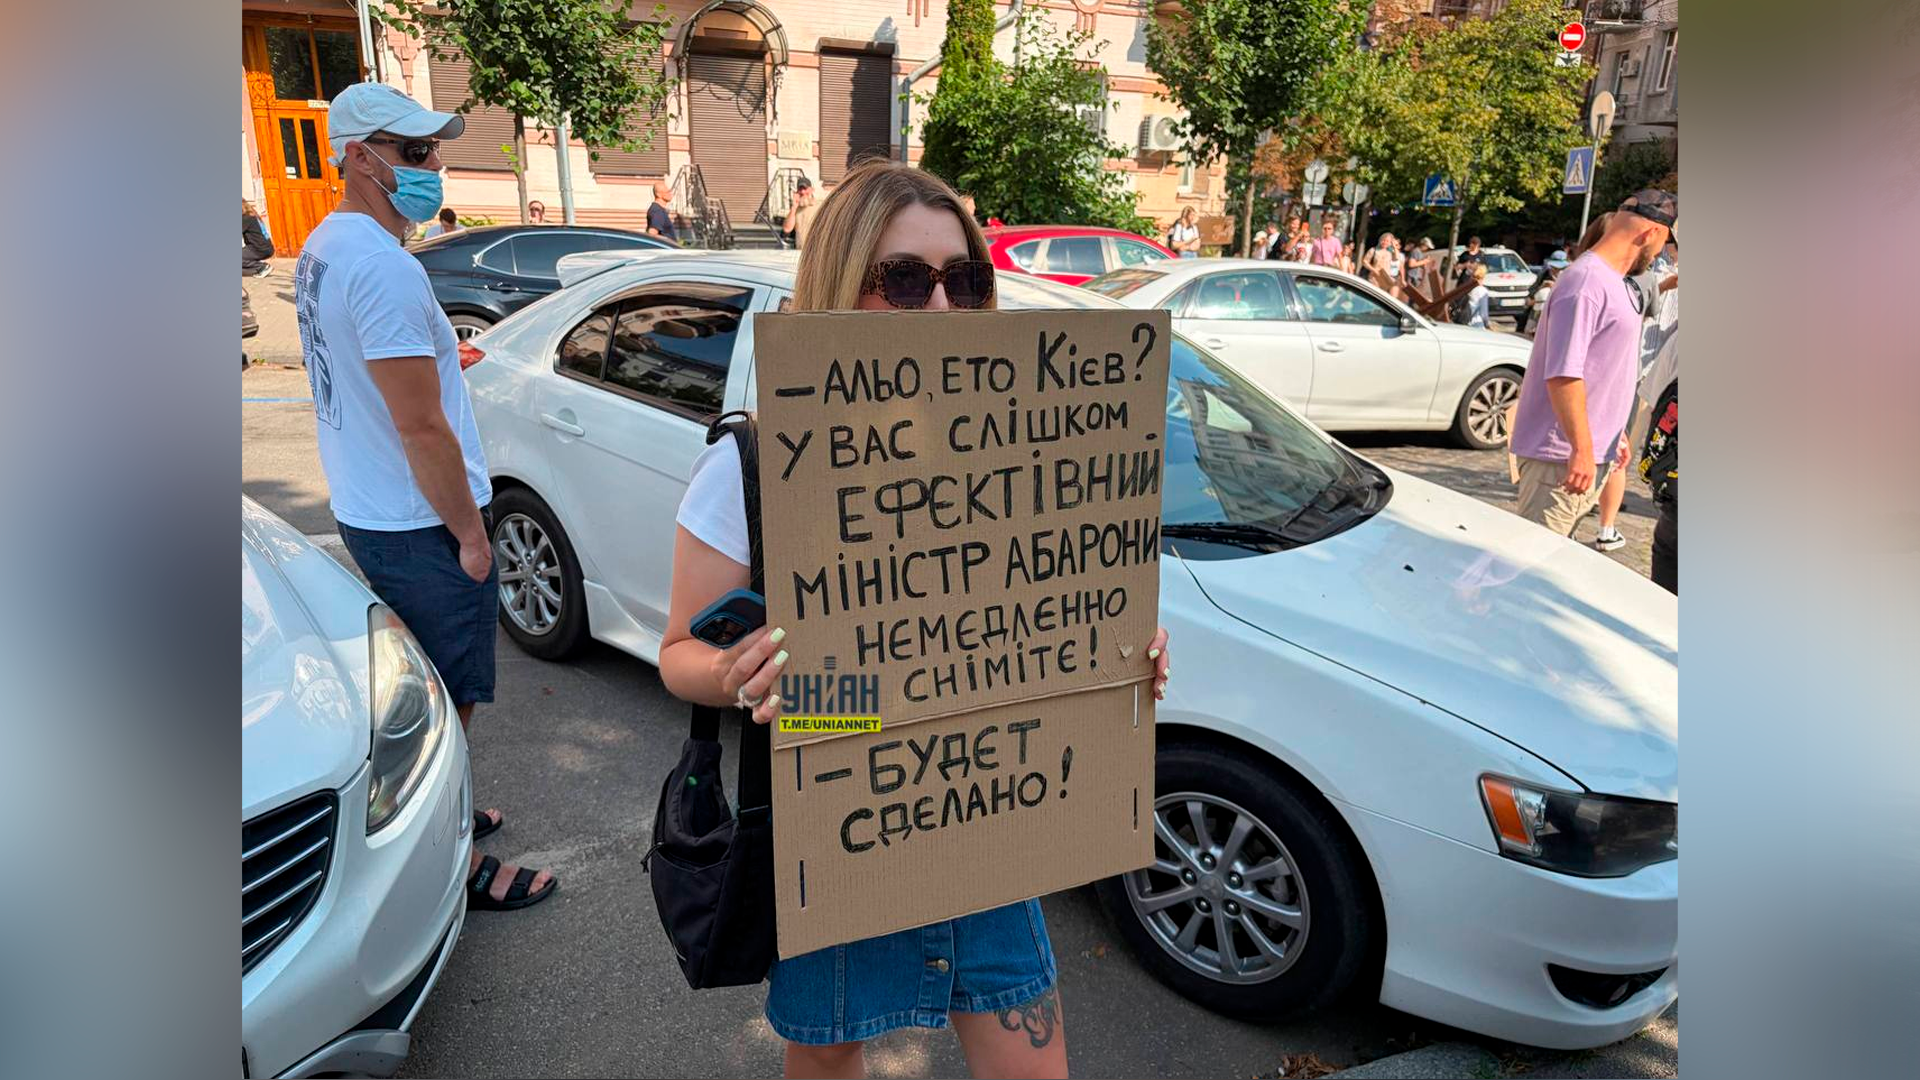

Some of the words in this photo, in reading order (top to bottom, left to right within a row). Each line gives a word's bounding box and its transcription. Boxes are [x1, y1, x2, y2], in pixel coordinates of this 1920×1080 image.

[941, 356, 1017, 395] ЕТО
[776, 429, 814, 482] У
[829, 420, 916, 469] ВАС
[1005, 520, 1161, 589] АБАРОНИ
